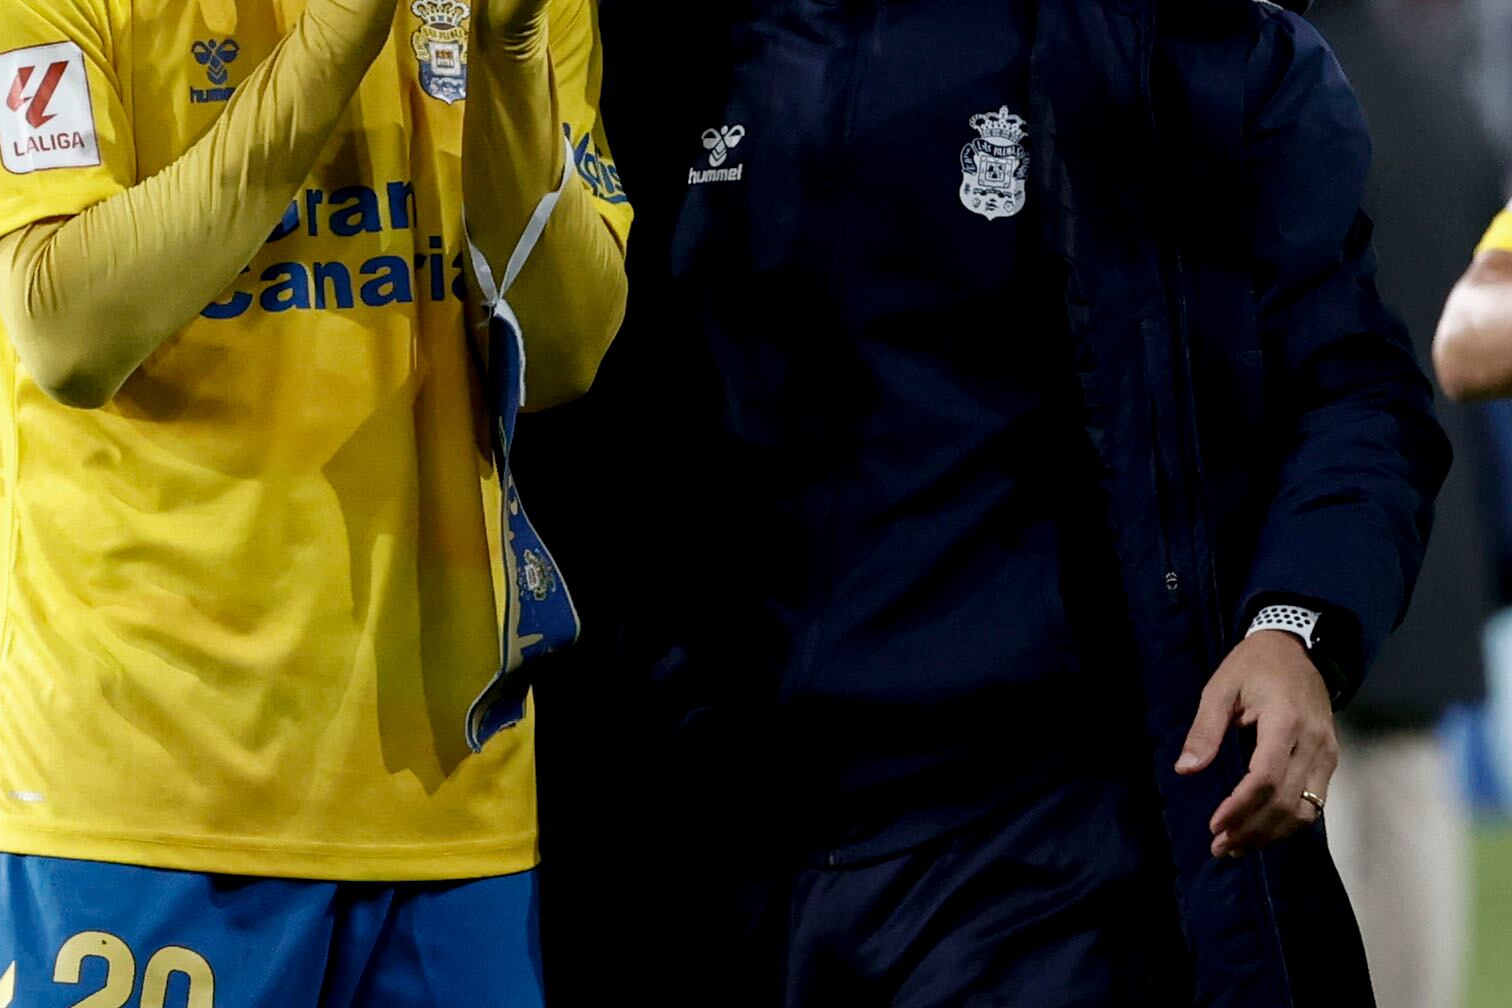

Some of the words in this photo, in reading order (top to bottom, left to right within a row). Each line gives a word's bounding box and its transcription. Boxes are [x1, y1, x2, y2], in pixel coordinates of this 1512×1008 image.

[14, 130, 86, 159] LALIGA
[688, 163, 743, 185] hummel
[53, 929, 216, 1008] 20
